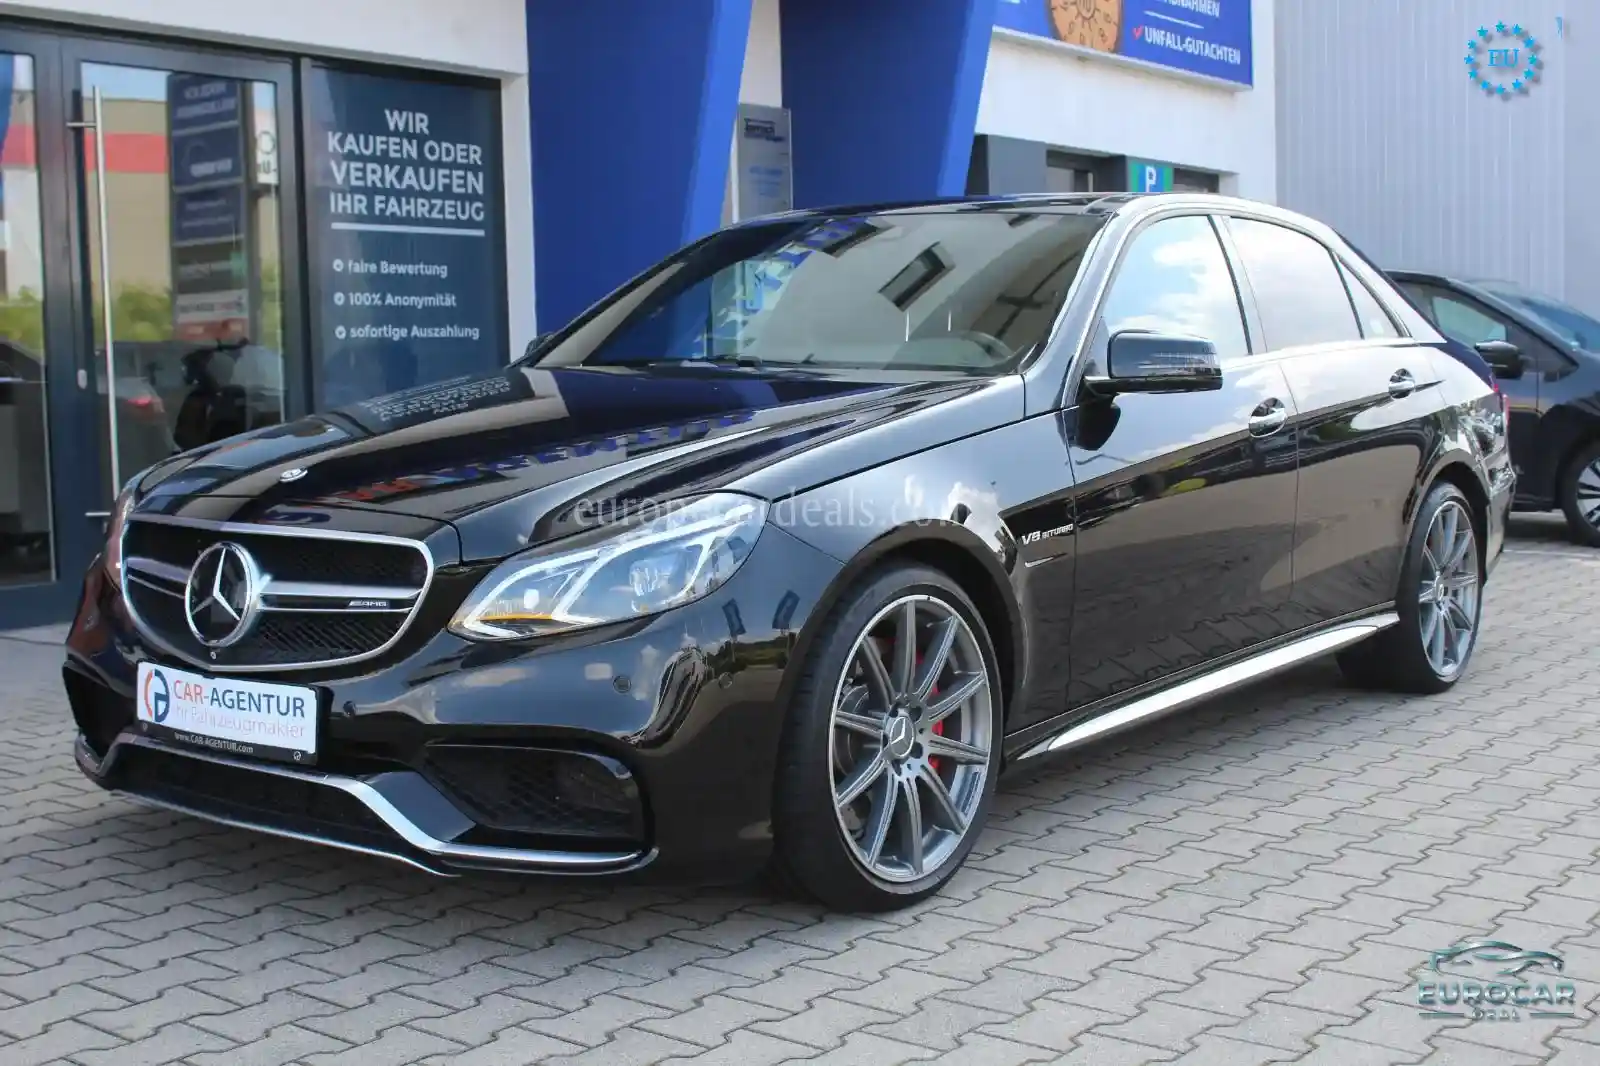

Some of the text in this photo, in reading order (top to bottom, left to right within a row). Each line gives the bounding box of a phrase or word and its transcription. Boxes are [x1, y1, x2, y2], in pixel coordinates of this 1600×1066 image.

[1163, 0, 1220, 18] NAHMEN
[1145, 26, 1241, 65] UNFALL-GUTACHTEN
[385, 109, 429, 134] WIR
[328, 131, 482, 165] KAUFEN ODER
[330, 160, 484, 194] VERKAUFEN
[1145, 166, 1156, 192] P
[330, 192, 485, 221] IHR FAHRZEUG
[348, 260, 448, 278] faire Bewertung
[349, 292, 457, 309] 100% Anonymität
[350, 324, 480, 341] sofortige Auszahlung
[1021, 530, 1041, 545] V8
[174, 679, 305, 718] CAR-AGENTUR
